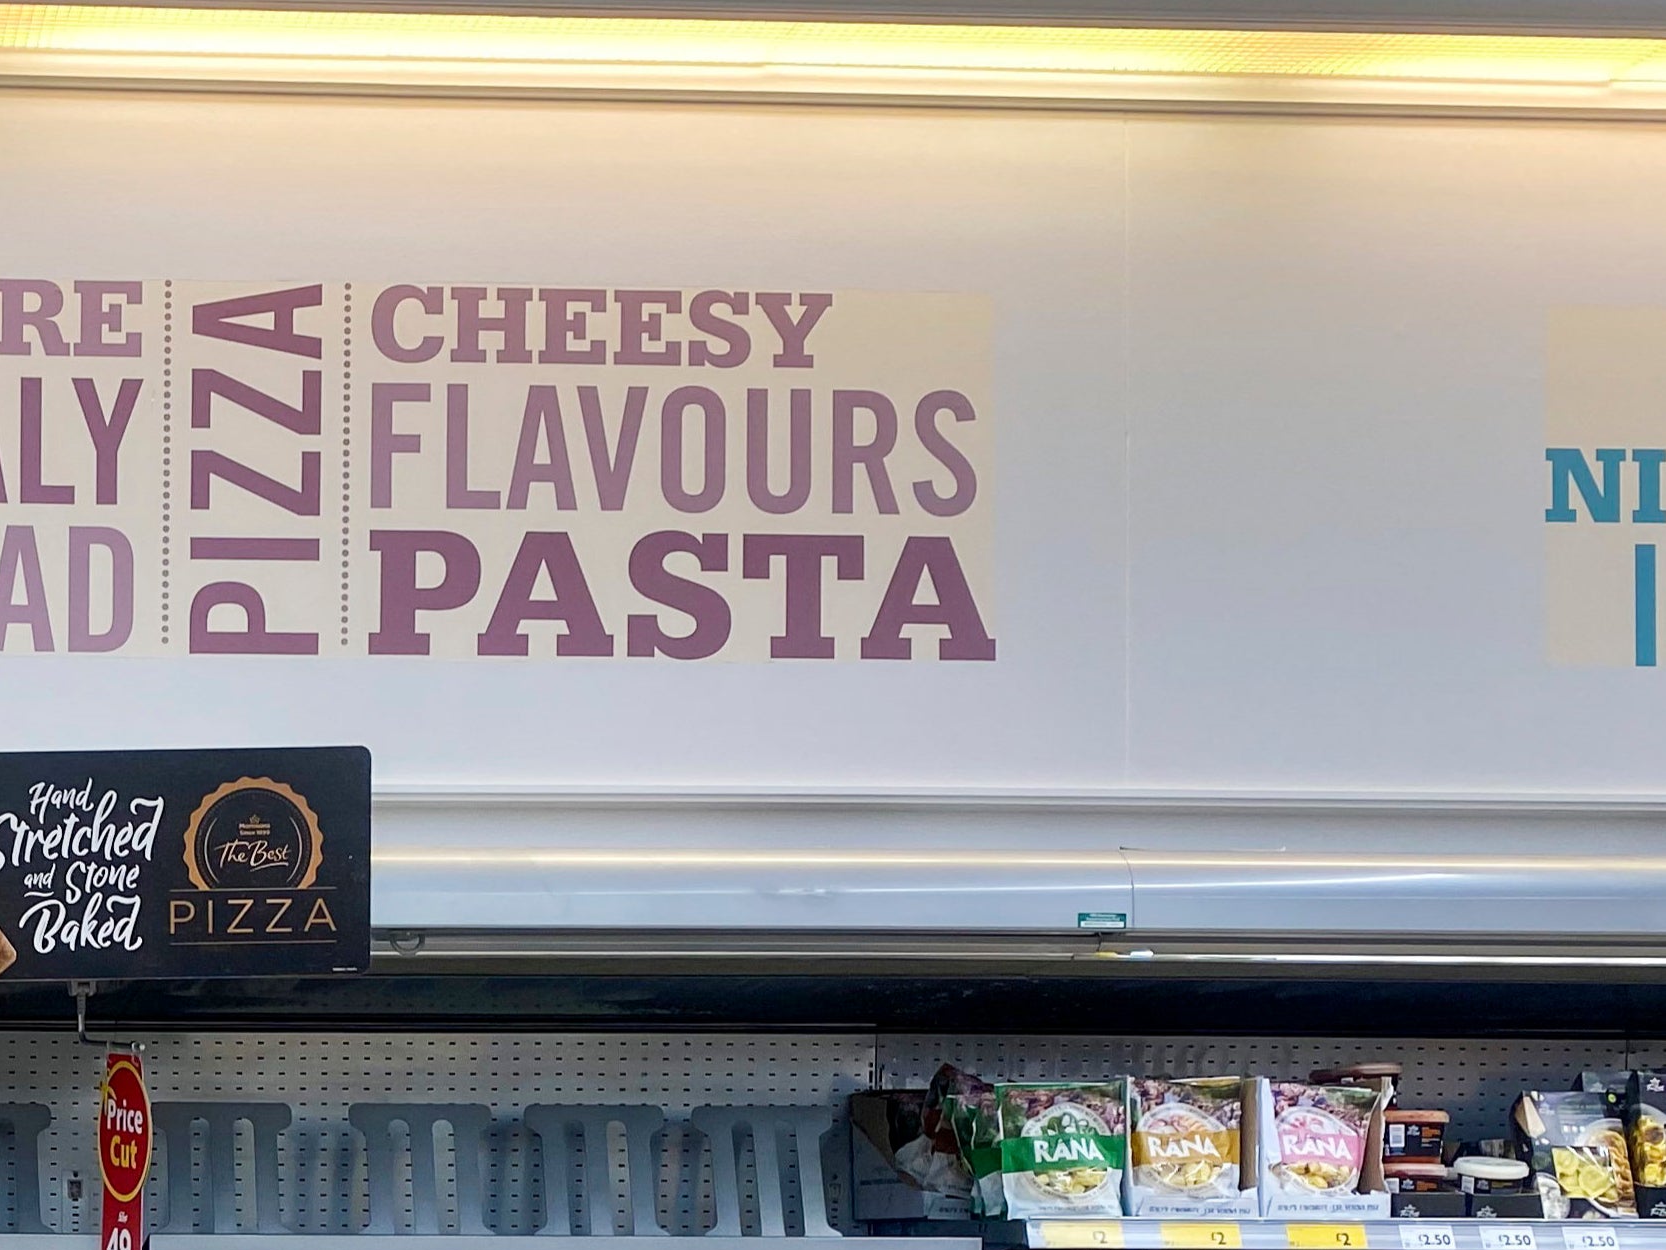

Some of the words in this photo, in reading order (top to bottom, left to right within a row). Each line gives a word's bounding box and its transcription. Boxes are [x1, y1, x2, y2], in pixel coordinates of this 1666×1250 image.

[371, 285, 833, 368] CHEESY
[370, 382, 978, 518] FLAVOURS
[189, 283, 323, 656] PIZZA
[367, 530, 997, 661] PASTA
[28, 777, 94, 823] Hand
[23, 862, 57, 898] and
[65, 860, 141, 904] Stone
[18, 893, 144, 954] Baked
[169, 897, 337, 935] PIZZA
[106, 1098, 144, 1135] Price
[109, 1134, 138, 1170] Cut
[1034, 1137, 1105, 1164] RANA
[1147, 1134, 1222, 1159] RANA
[1284, 1134, 1353, 1161] RANA
[1092, 1230, 1109, 1245] £2
[1211, 1231, 1227, 1246] £2
[1336, 1231, 1352, 1247] £2
[1418, 1234, 1452, 1246] £2.50
[1498, 1234, 1532, 1247] £2.50
[1583, 1235, 1616, 1248] £2.50
